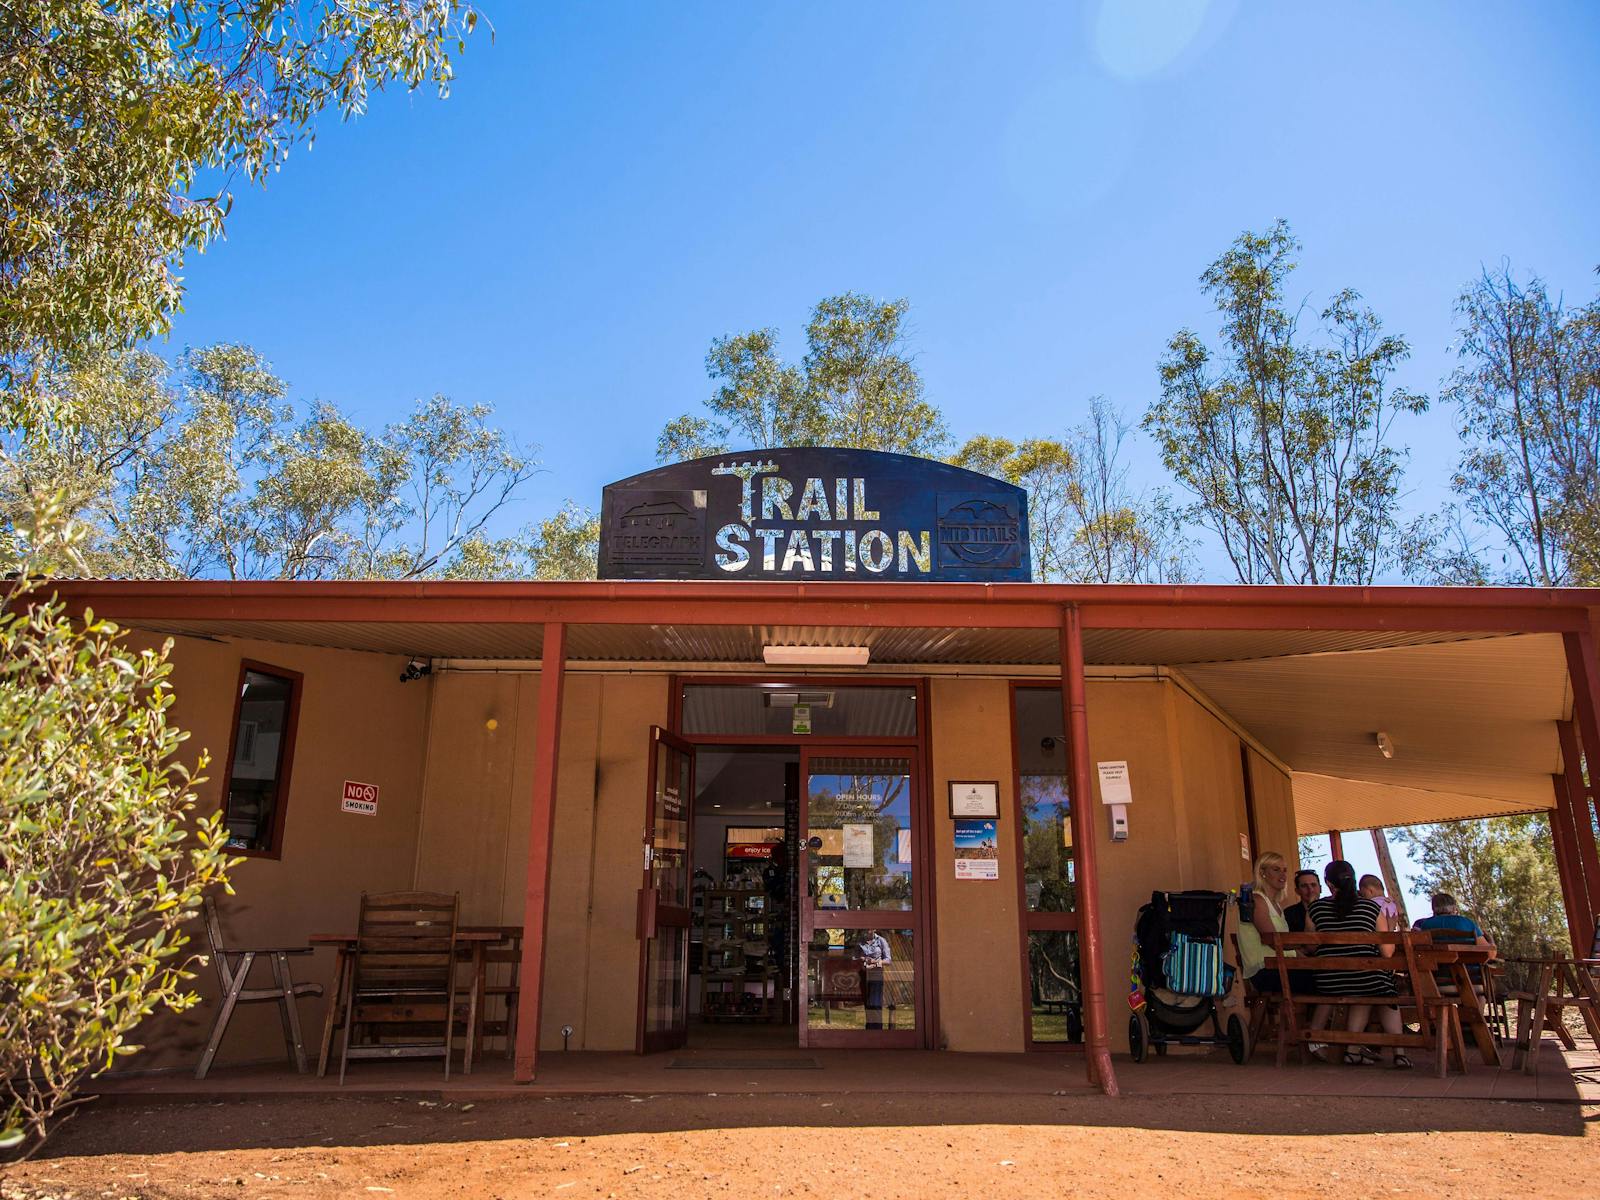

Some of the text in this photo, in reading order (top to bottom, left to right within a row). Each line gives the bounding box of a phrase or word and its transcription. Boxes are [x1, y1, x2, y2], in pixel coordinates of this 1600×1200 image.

[711, 460, 880, 526] TRAIL
[971, 527, 1017, 542] TRAILS
[715, 523, 931, 572] STATION
[348, 785, 363, 798] NO
[345, 801, 374, 811] SMOKING
